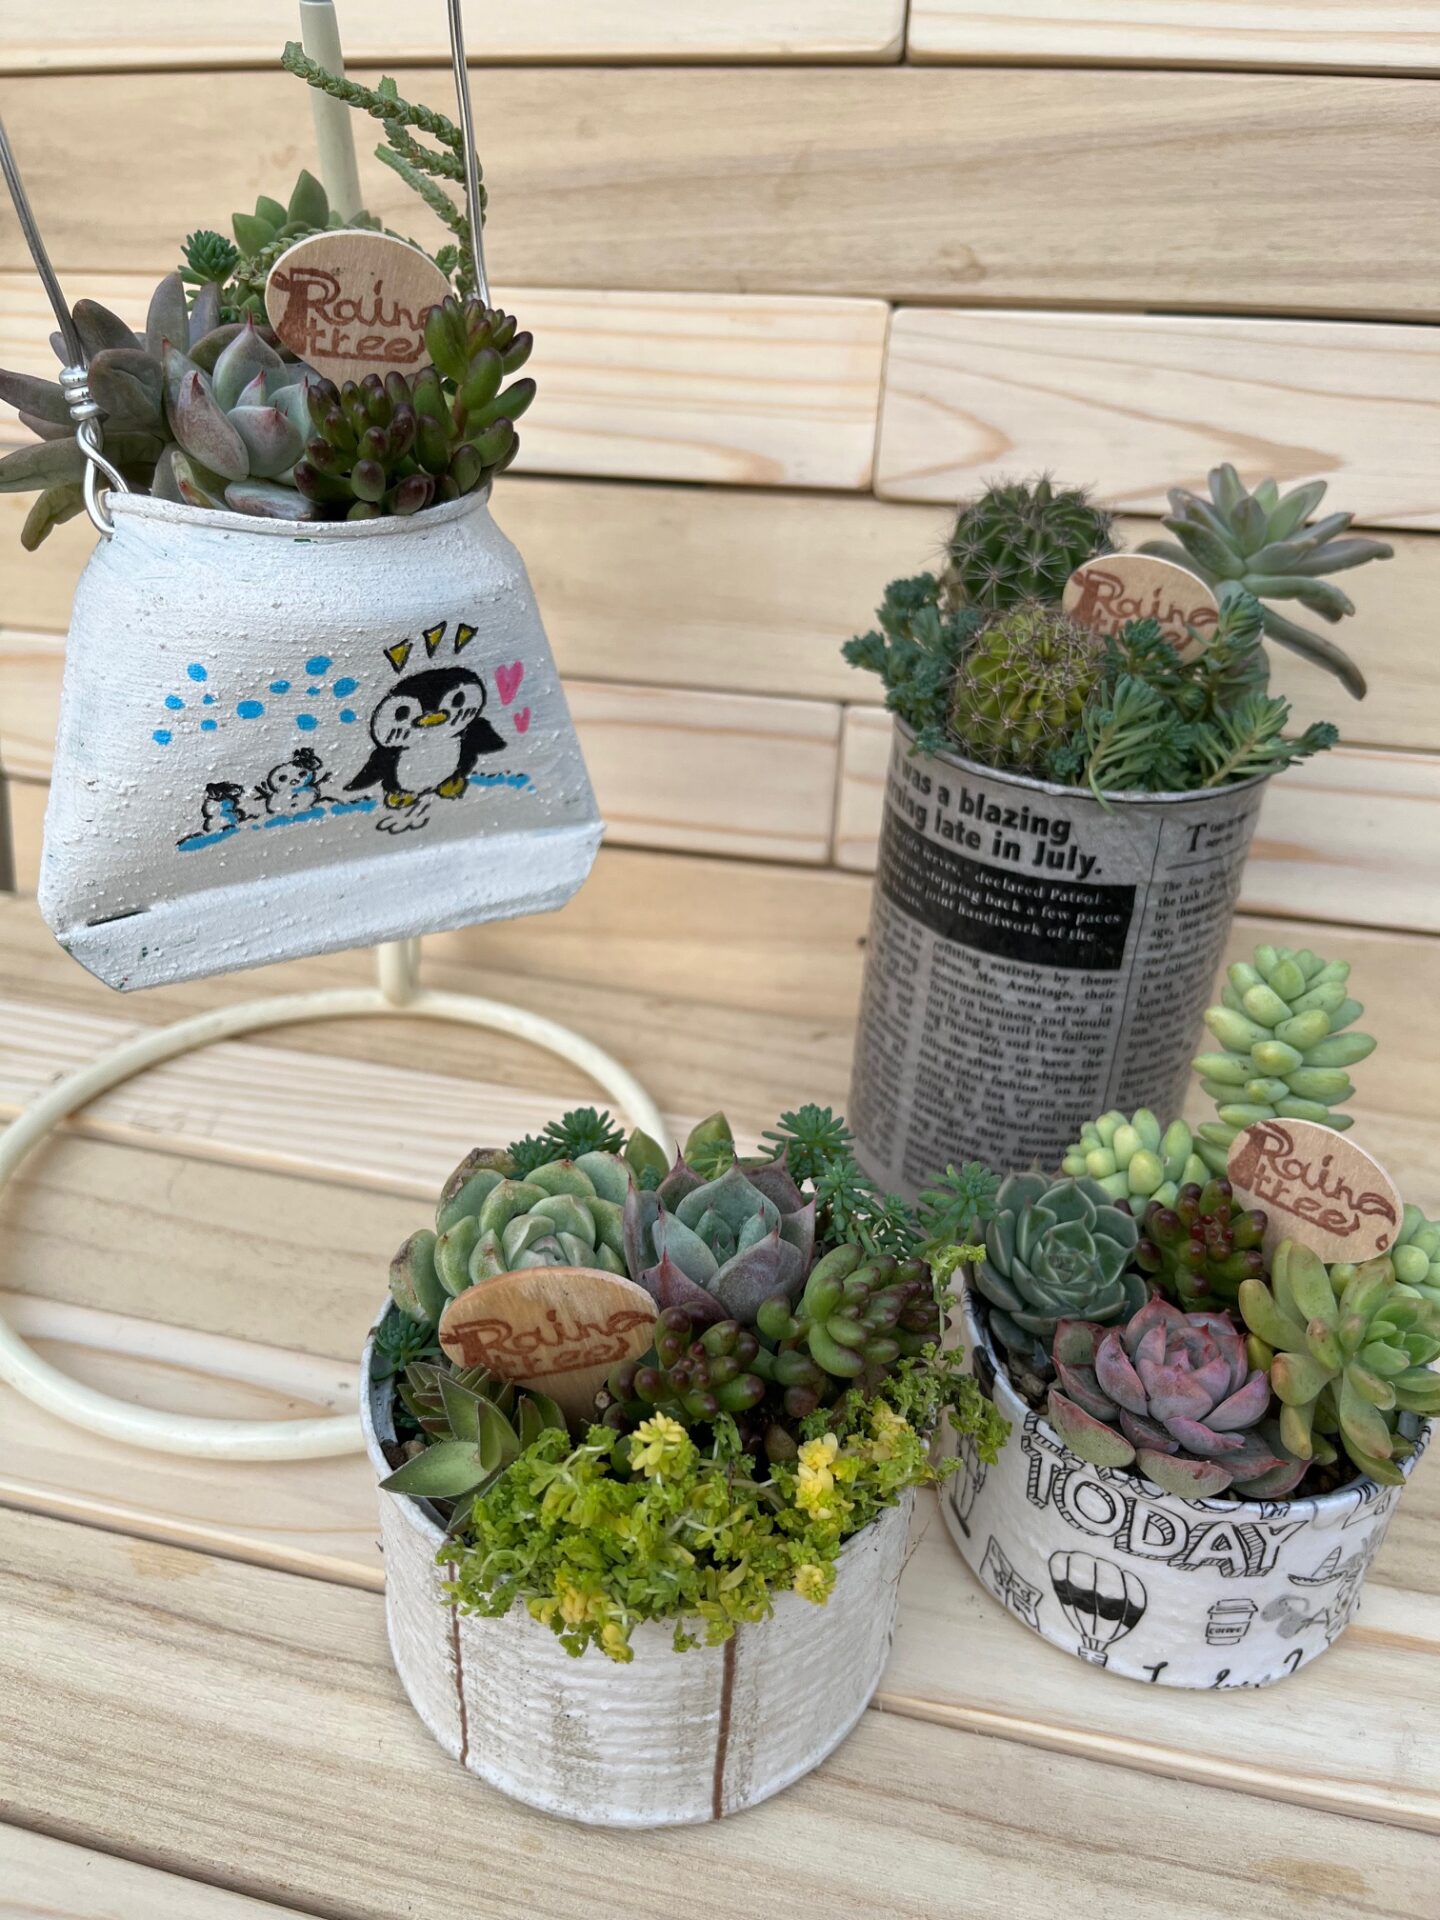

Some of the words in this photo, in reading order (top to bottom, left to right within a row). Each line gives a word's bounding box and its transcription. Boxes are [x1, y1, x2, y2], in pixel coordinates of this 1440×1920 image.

[307, 317, 425, 363] tree
[902, 758, 933, 796] was
[937, 785, 950, 808] a
[959, 787, 1072, 846] blazing
[934, 807, 982, 851] late
[991, 829, 1022, 862] in
[1031, 840, 1103, 881] July.
[974, 871, 1044, 900] declared
[957, 902, 1042, 938] handiwork
[1046, 924, 1065, 940] of
[1068, 925, 1097, 942] the
[985, 890, 1022, 914] back
[1026, 905, 1036, 917] a
[1040, 903, 1071, 922] few
[1074, 910, 1122, 927] paces
[932, 940, 982, 969] refitting
[990, 961, 1043, 983] entirely
[1054, 972, 1071, 986] by
[1080, 973, 1119, 987] them-
[1006, 980, 1074, 1002] Armitage,
[1084, 987, 1117, 1000] their
[1017, 998, 1043, 1011] was
[1055, 1003, 1088, 1016] away
[1101, 1002, 1113, 1014] in
[965, 1009, 994, 1029] back
[998, 1022, 1031, 1037] until
[1035, 1026, 1057, 1041] the
[1061, 1028, 1107, 1042] follow-
[979, 998, 1038, 1026] business,
[1041, 1013, 1067, 1028] and
[1070, 1016, 1112, 1028] would
[944, 1016, 1001, 1047] Thursday,
[1005, 1036, 1031, 1051] and
[1052, 1045, 1077, 1056] was
[1041, 1056, 1072, 1069] have
[1081, 1056, 1102, 1069] the
[1253, 1163, 1361, 1238] tree
[1021, 1434, 1310, 1579] TODAY
